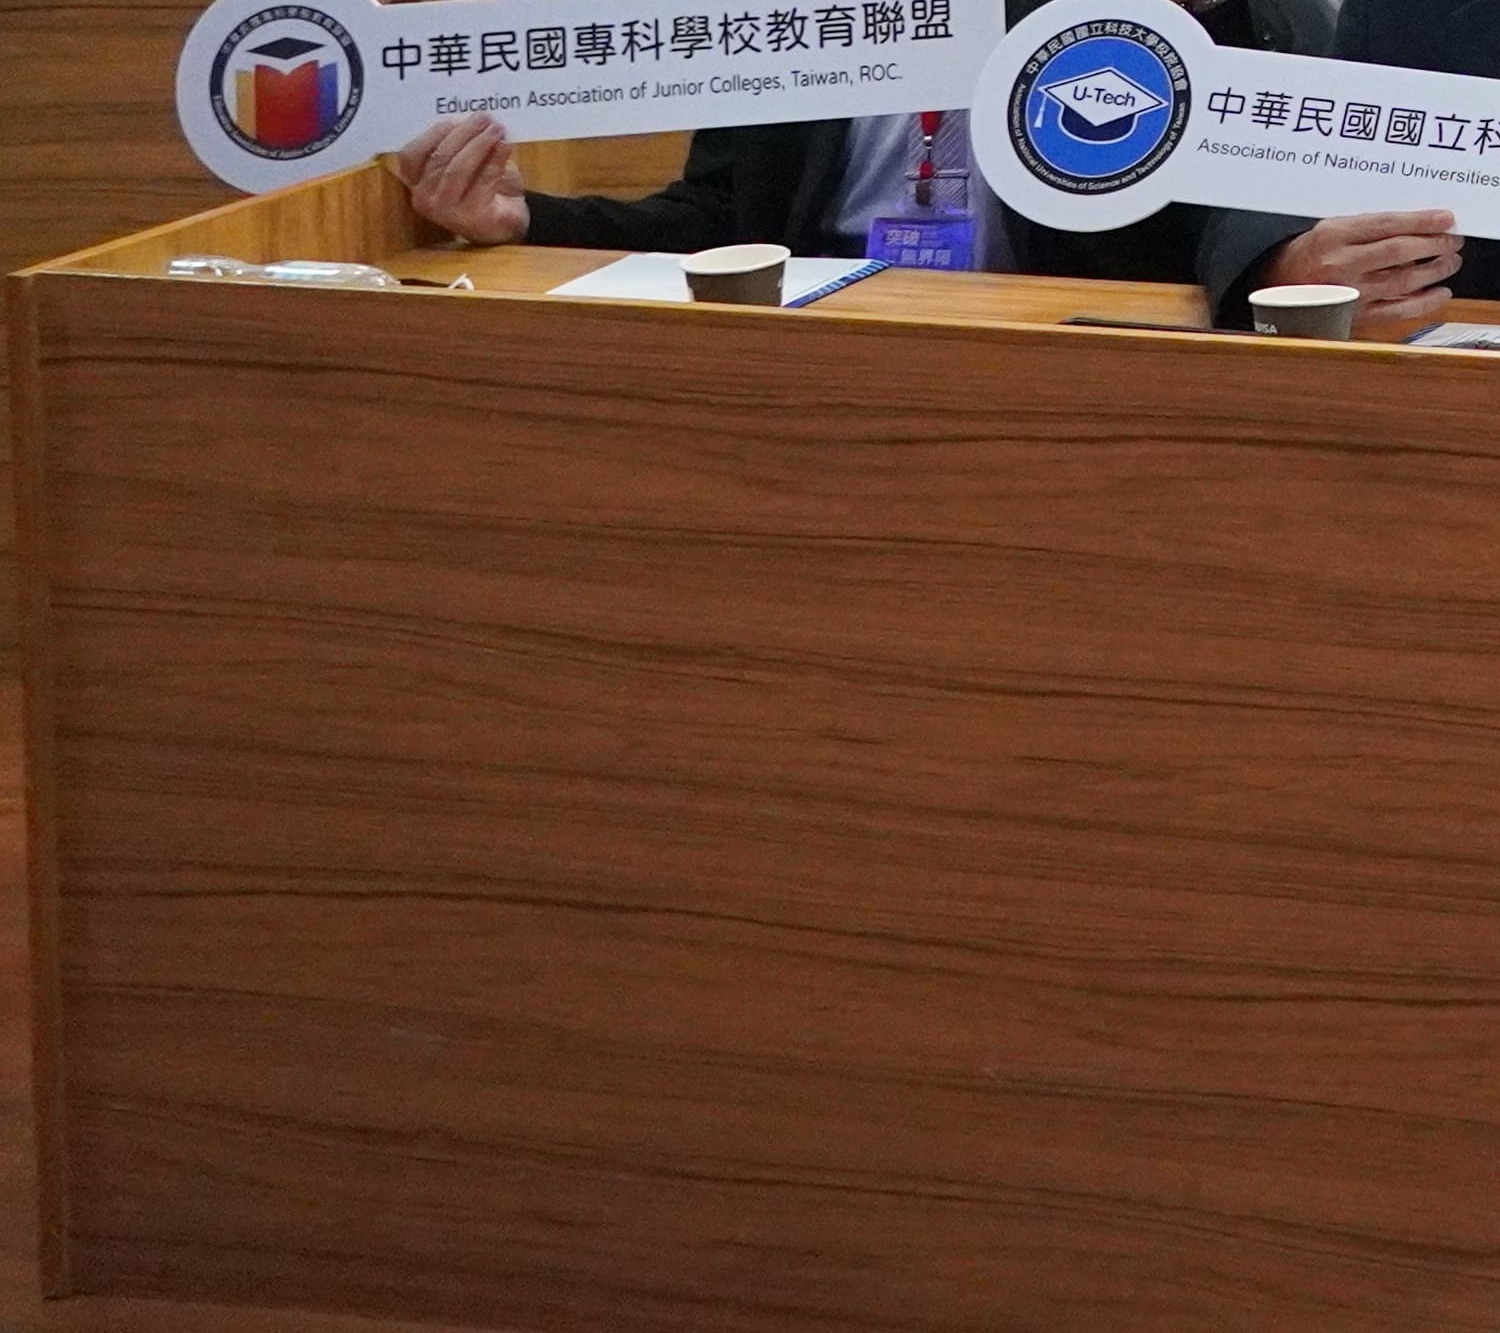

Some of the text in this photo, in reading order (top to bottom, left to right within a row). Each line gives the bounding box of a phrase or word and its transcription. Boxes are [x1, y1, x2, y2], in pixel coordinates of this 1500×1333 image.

[436, 92, 521, 116] Education
[527, 85, 625, 108] Association
[629, 81, 647, 100] of
[652, 78, 704, 98] Junior
[710, 72, 786, 97] Colleges,
[791, 69, 854, 89] Taiwan,
[1073, 85, 1136, 108] U-Tech
[1197, 138, 1296, 163] Association
[1302, 151, 1321, 166] of
[1324, 153, 1395, 175] National
[1401, 162, 1500, 188] Universities
